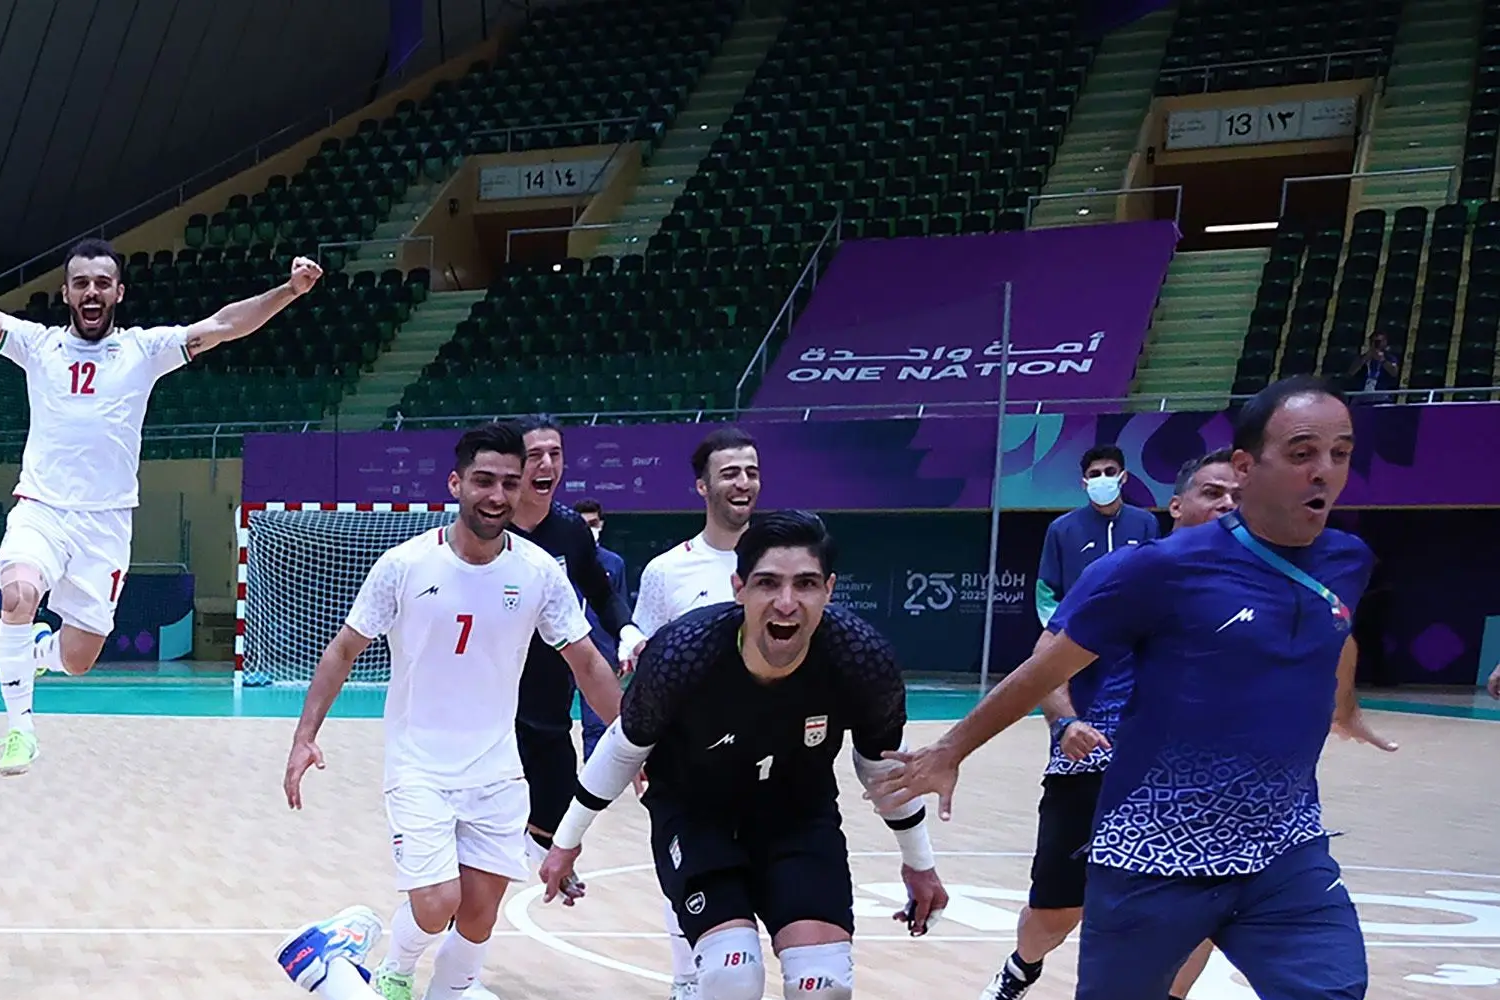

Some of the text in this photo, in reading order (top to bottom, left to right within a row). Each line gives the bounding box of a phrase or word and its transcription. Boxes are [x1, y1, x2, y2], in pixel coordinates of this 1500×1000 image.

[1225, 112, 1252, 136] 13
[1266, 110, 1296, 132] ١٣
[524, 170, 545, 190] 14
[555, 168, 577, 187] ١٤
[68, 361, 96, 394] 12
[787, 358, 1094, 382] ONE NATION
[455, 614, 473, 655] 7
[756, 755, 774, 780] 1
